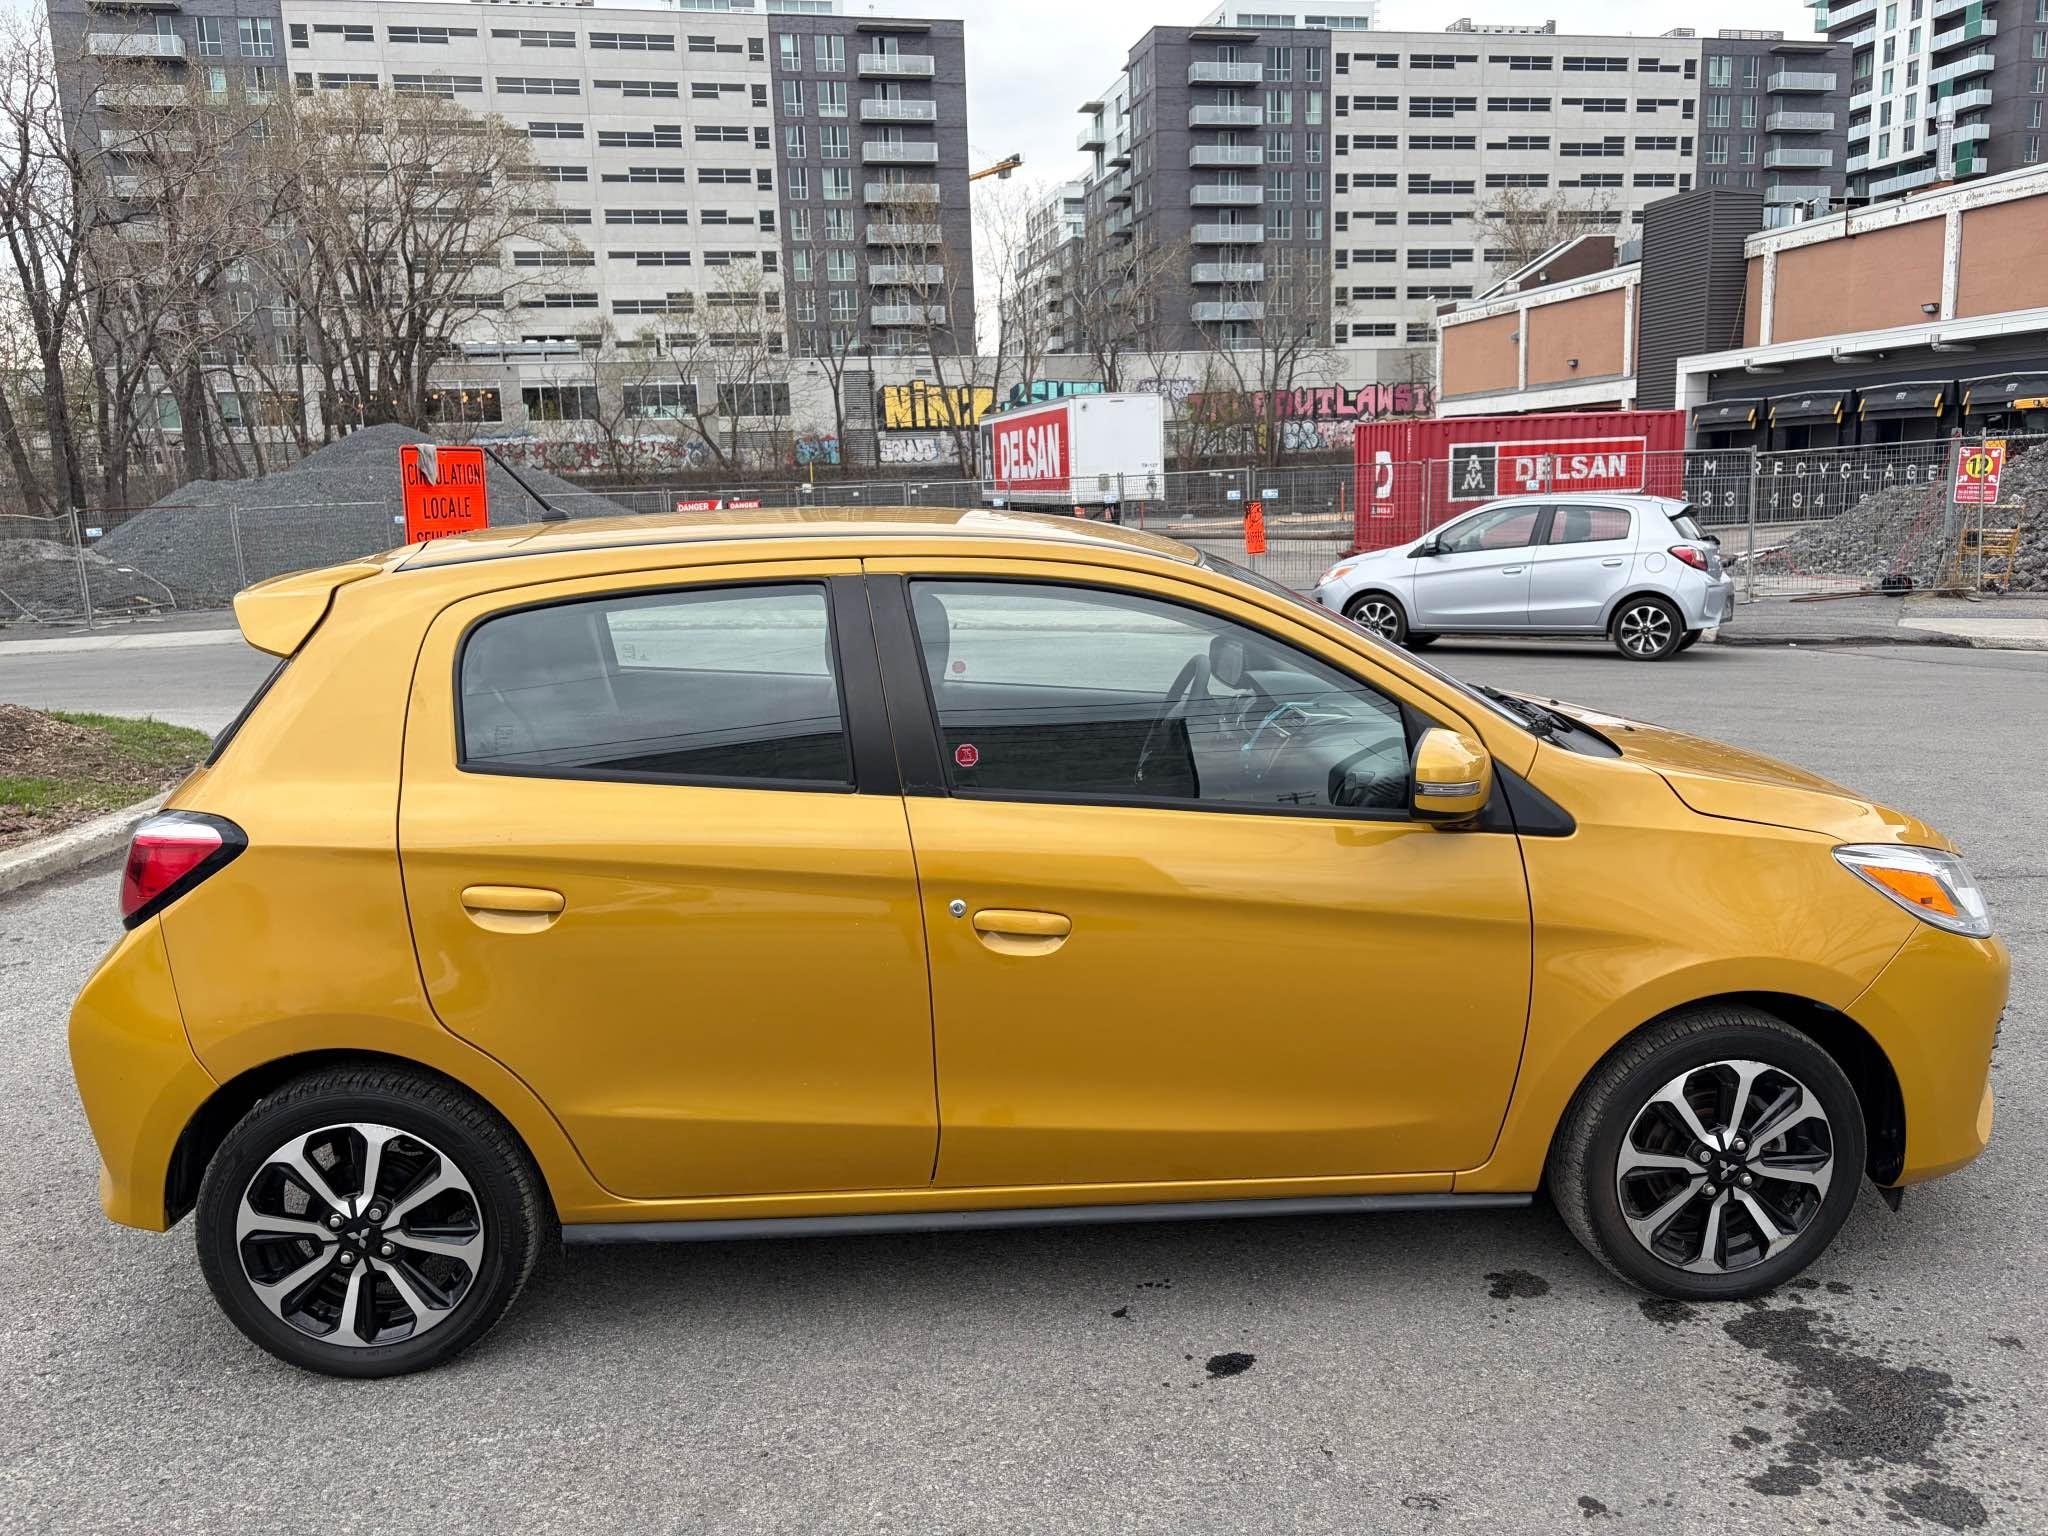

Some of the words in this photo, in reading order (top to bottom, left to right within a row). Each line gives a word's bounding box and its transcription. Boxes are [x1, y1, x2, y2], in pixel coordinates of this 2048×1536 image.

[1000, 423, 1060, 479] DELSAN
[1515, 454, 1627, 482] DELSAN
[1970, 457, 1989, 474] 12
[423, 496, 472, 519] LOCALE
[678, 502, 709, 512] DANGER
[730, 501, 758, 510] DANGER
